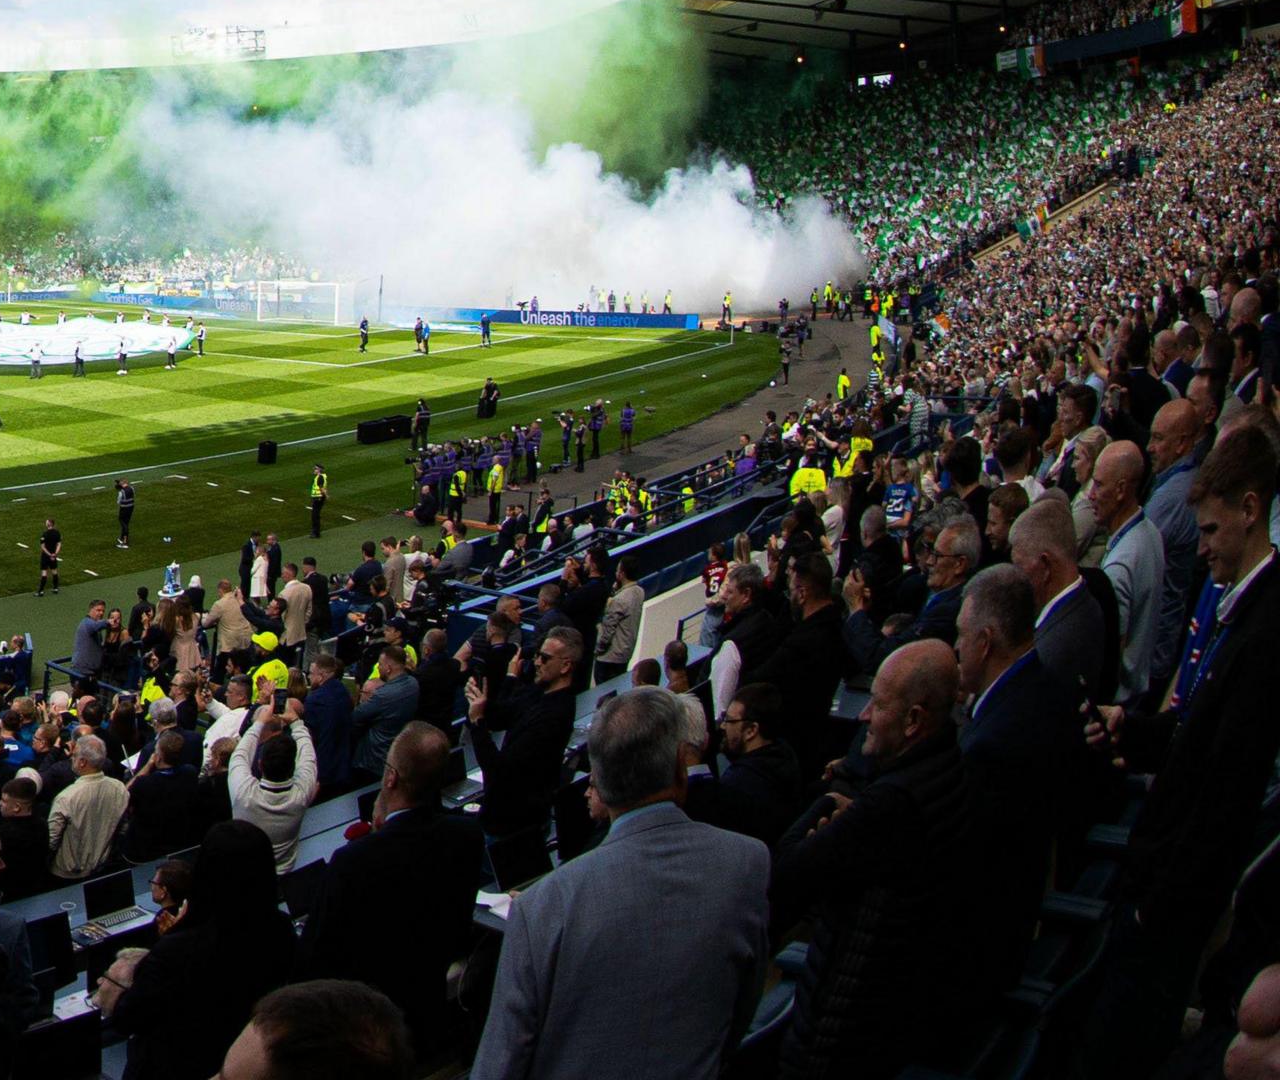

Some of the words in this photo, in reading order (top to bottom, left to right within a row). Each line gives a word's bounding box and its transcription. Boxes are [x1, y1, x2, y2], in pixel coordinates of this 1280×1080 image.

[520, 310, 572, 326] Unleash
[574, 312, 596, 327] the
[597, 314, 640, 329] energy
